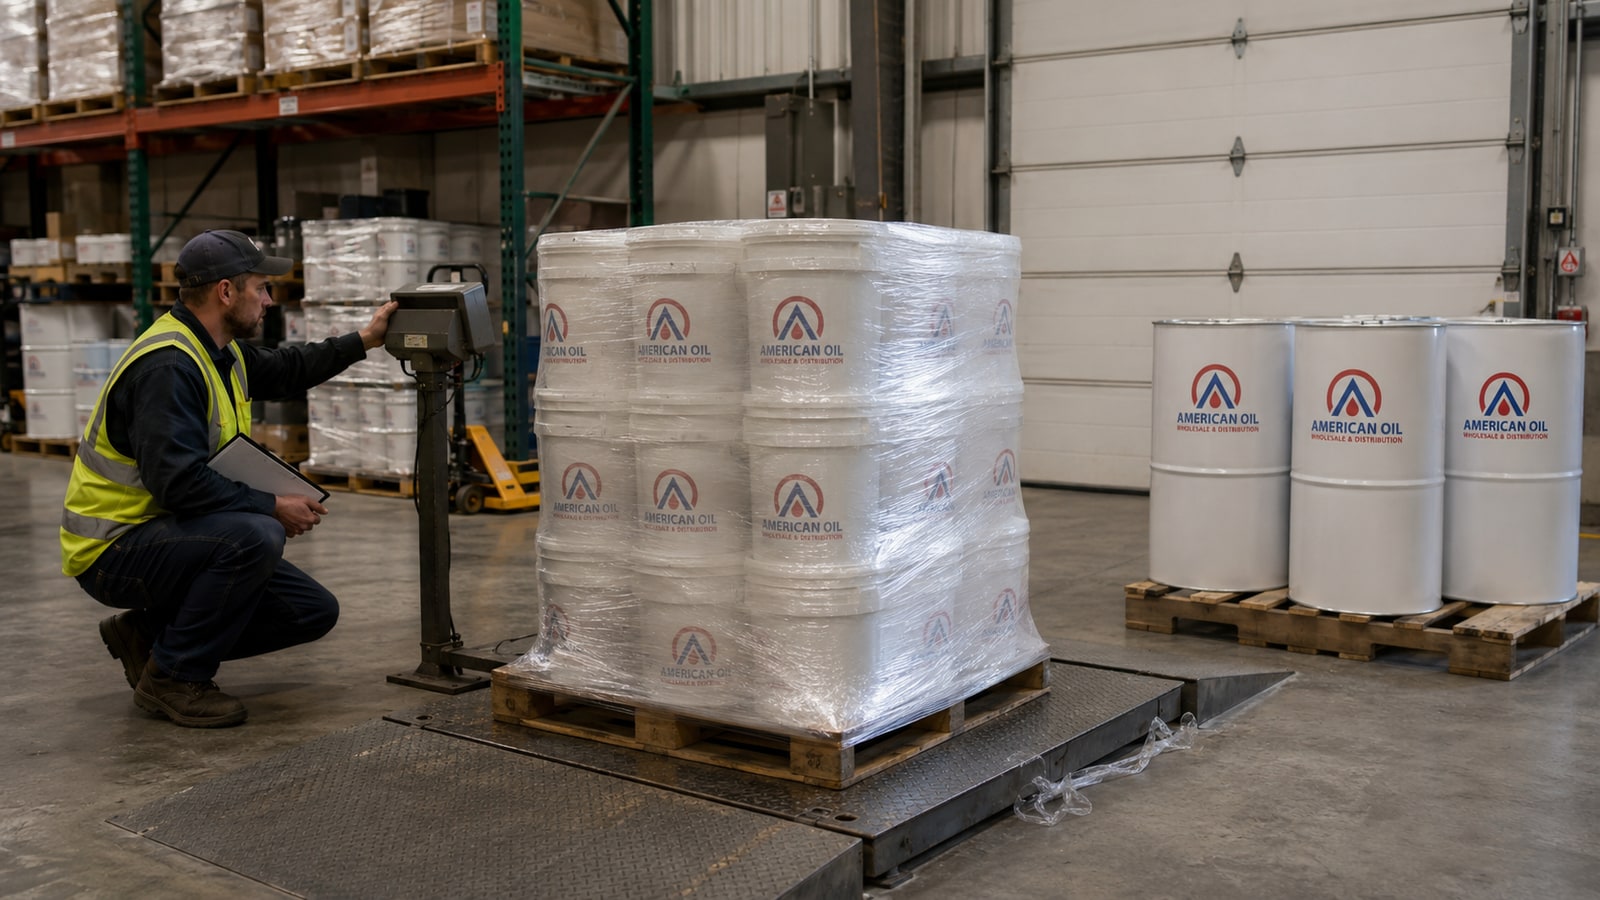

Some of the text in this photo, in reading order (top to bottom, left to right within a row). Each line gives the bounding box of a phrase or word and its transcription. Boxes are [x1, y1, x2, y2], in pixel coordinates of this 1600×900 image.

[568, 346, 587, 356] OIL
[638, 345, 711, 356] AMERICAN OIL
[760, 345, 844, 356] AMERICAN OIL
[1177, 412, 1259, 425] AMERICAN OIL
[1177, 425, 1210, 433] WHOLESALE
[1311, 419, 1403, 435] AMERICAN OIL
[1463, 419, 1548, 432] AMERICAN OIL
[1311, 433, 1346, 442] WHOLESALE
[1354, 436, 1403, 444] DISTRIBUTION
[1463, 432, 1498, 440] WHOLESALE
[553, 502, 620, 514] AMERICAN OIL
[644, 512, 718, 525] AMERICAN OIL
[762, 519, 843, 533] AMERICAN OIL
[660, 666, 714, 680] AMERICAN
